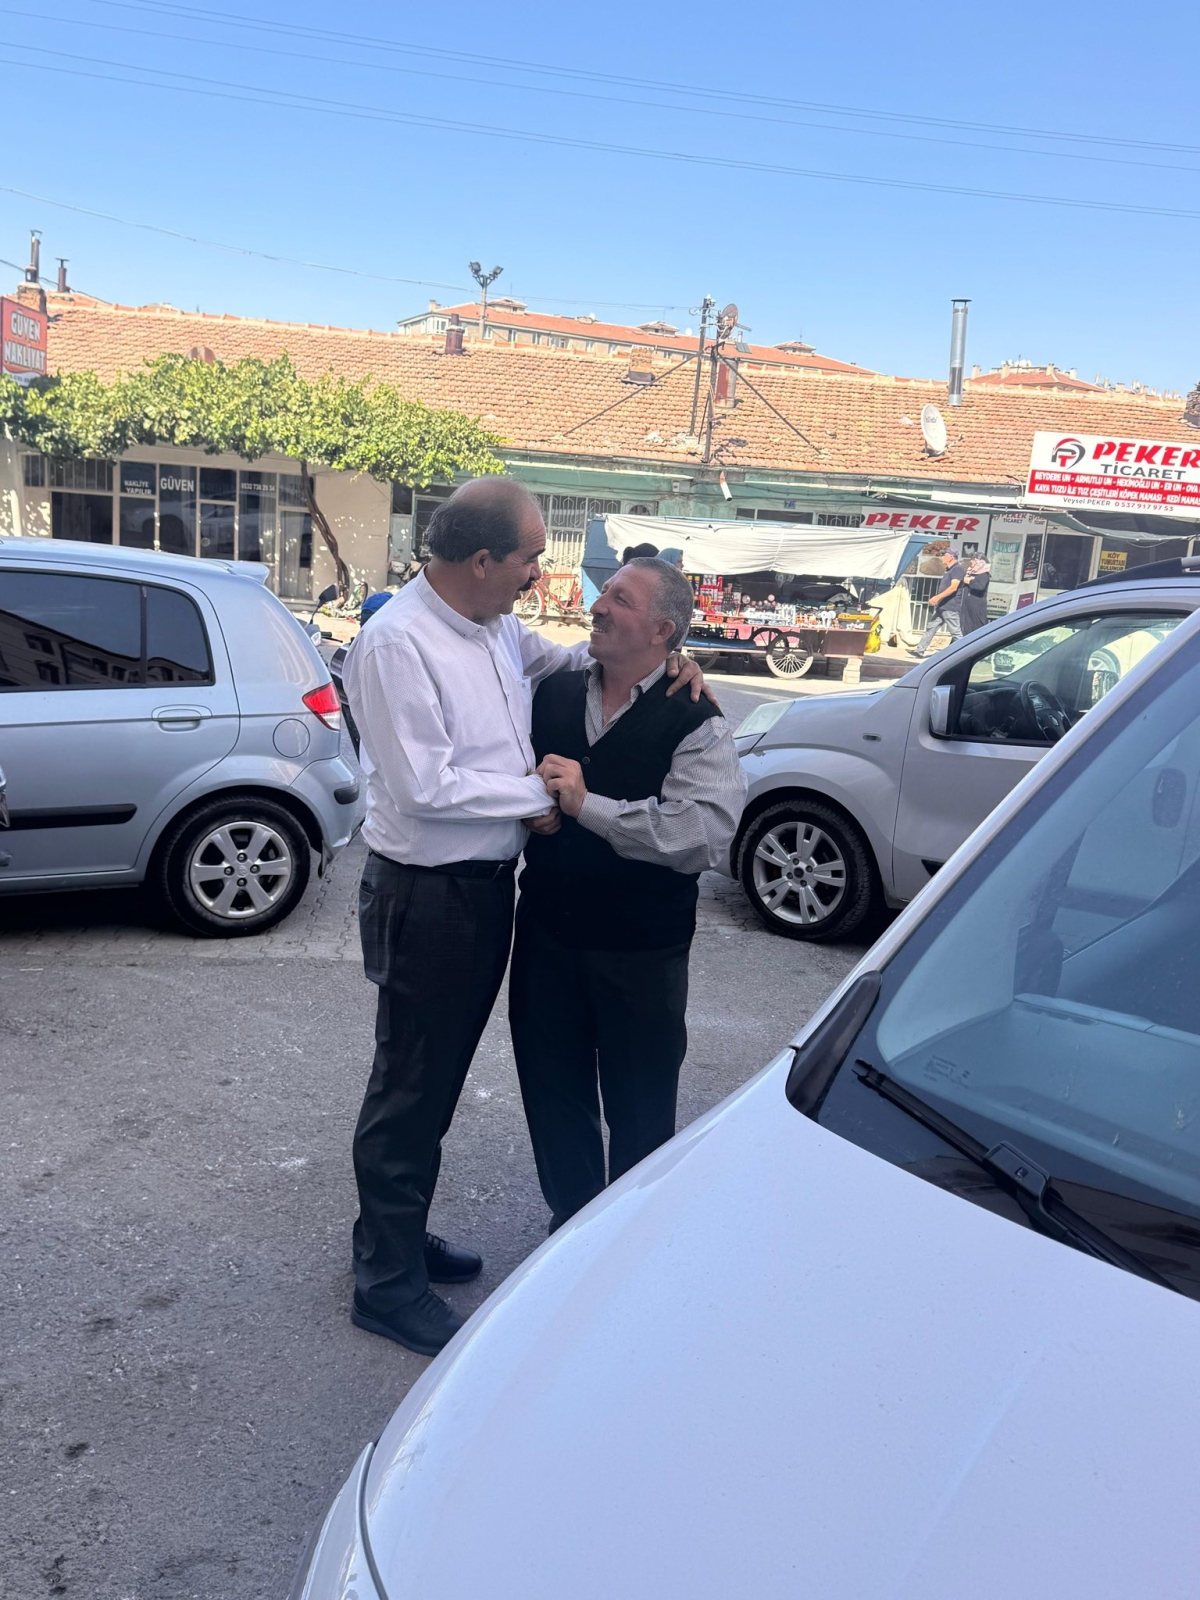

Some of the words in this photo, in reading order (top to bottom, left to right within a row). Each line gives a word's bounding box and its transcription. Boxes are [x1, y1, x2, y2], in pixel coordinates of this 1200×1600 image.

[11, 308, 40, 341] GÜVEN
[4, 340, 46, 371] NAKLİYAT
[1092, 441, 1200, 469] PEKER
[1100, 461, 1186, 480] TİCARET
[124, 480, 149, 488] NAKLİYE
[160, 476, 194, 492] GÜVEN
[1034, 471, 1062, 482] BEYDERE
[1062, 474, 1071, 483] UN
[1075, 475, 1102, 484] ARMUTLU
[1103, 477, 1113, 486] UN
[1116, 476, 1151, 489] HEKİMOĞLU
[1151, 481, 1161, 490] UN
[1164, 482, 1173, 491] ER
[1173, 483, 1182, 492] UN
[1186, 484, 1199, 493] OVA
[1034, 484, 1050, 493] KAYA
[1051, 485, 1067, 495] TUZU
[1067, 484, 1077, 495] İLE
[1078, 487, 1089, 496] TUZ
[1119, 488, 1139, 500] KÖPEK
[1139, 491, 1163, 502] MAMASI
[1063, 497, 1086, 505] Veysel
[866, 512, 980, 531] PEKER
